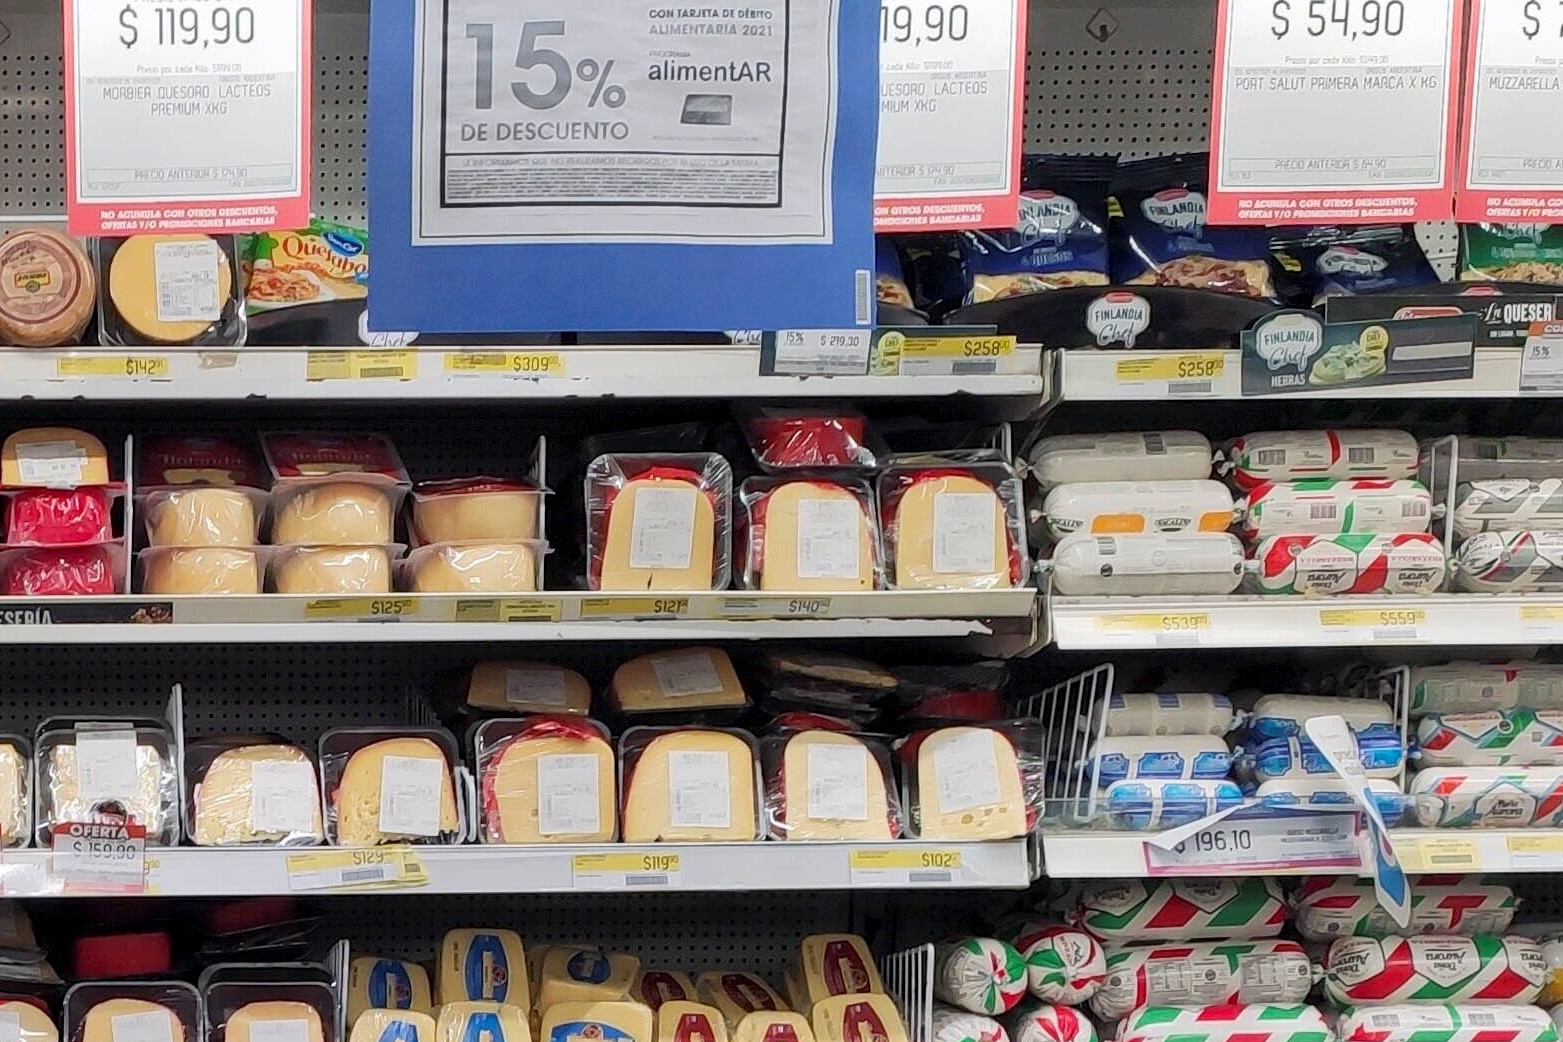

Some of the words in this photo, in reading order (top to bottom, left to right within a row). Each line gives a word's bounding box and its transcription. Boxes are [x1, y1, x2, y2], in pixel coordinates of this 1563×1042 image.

[673, 9, 720, 20] TARJETA
[722, 9, 736, 19] DE
[1271, 0, 1289, 40] $
[1307, 0, 1404, 41] 54,90
[119, 4, 138, 48] $
[155, 6, 254, 50] 119,90
[649, 24, 738, 36] ALIMENTARIA
[742, 25, 773, 37] 2021
[880, 5, 969, 47] 19,90
[465, 20, 627, 111] 15%
[648, 59, 772, 83] alimentAR
[103, 85, 152, 99] MORBIER
[157, 85, 210, 99] QUESORO
[218, 83, 271, 98] LACTEOS
[881, 83, 926, 97] UESORO
[934, 81, 988, 95] LACTEOS
[1235, 77, 1264, 91] PORT
[1269, 76, 1306, 90] SALUT
[1310, 76, 1359, 90] PRIMERA
[1363, 75, 1405, 90] MARCA
[1420, 75, 1438, 89] KG
[1489, 76, 1560, 90] MUZZARELLA
[151, 102, 201, 116] PREMIUM
[881, 100, 910, 112] MIUM
[461, 123, 488, 142] DE
[496, 121, 629, 141] DESCUENTO
[1095, 308, 1143, 322] FINLANDIA
[1264, 331, 1315, 344] FINLANDIA
[1270, 346, 1308, 371] Chef
[1271, 373, 1306, 387] HEBRAS
[70, 823, 130, 840] OFERTA
